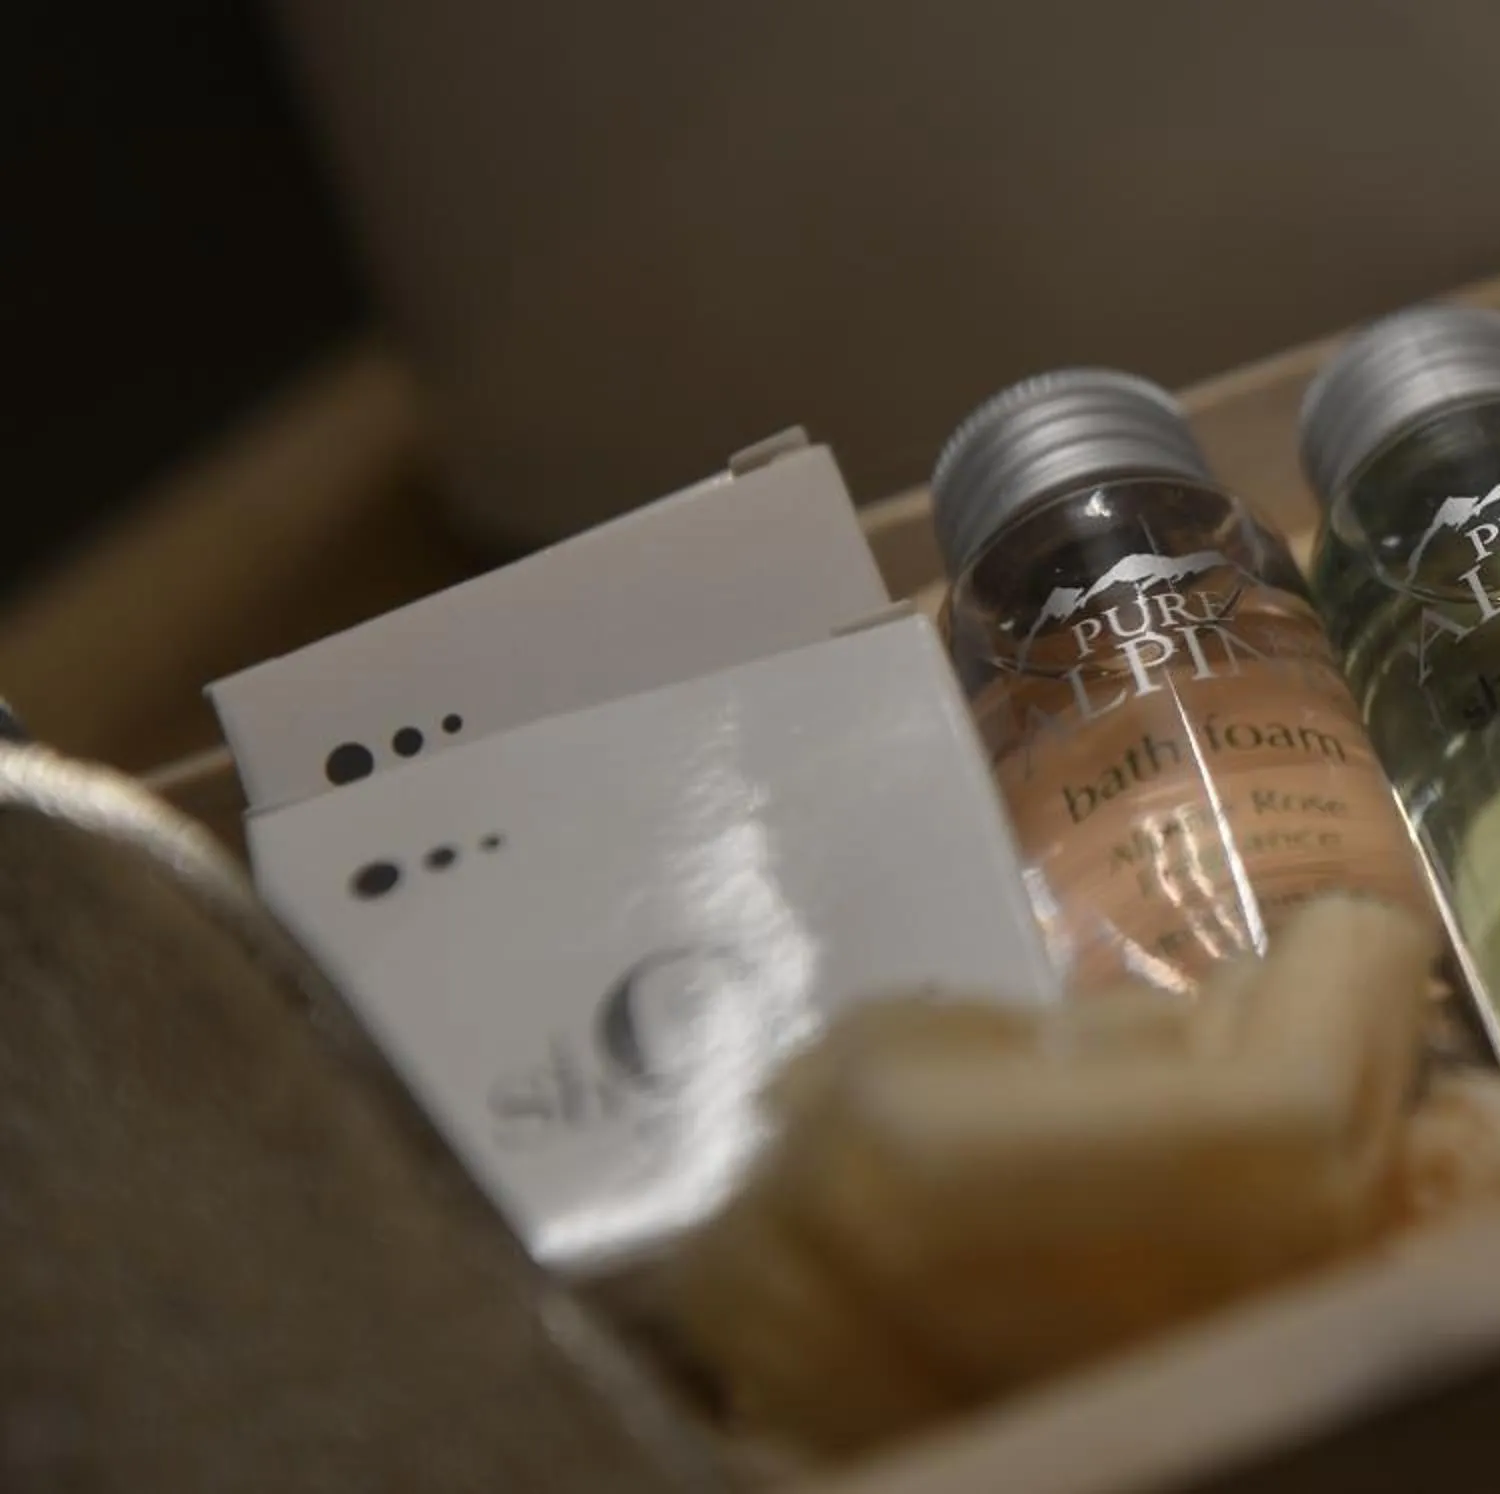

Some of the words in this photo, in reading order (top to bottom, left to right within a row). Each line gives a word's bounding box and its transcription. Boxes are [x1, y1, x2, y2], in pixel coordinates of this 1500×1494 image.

[1070, 591, 1236, 660] PURE
[1061, 732, 1183, 823] bath
[1200, 712, 1347, 766] foam
